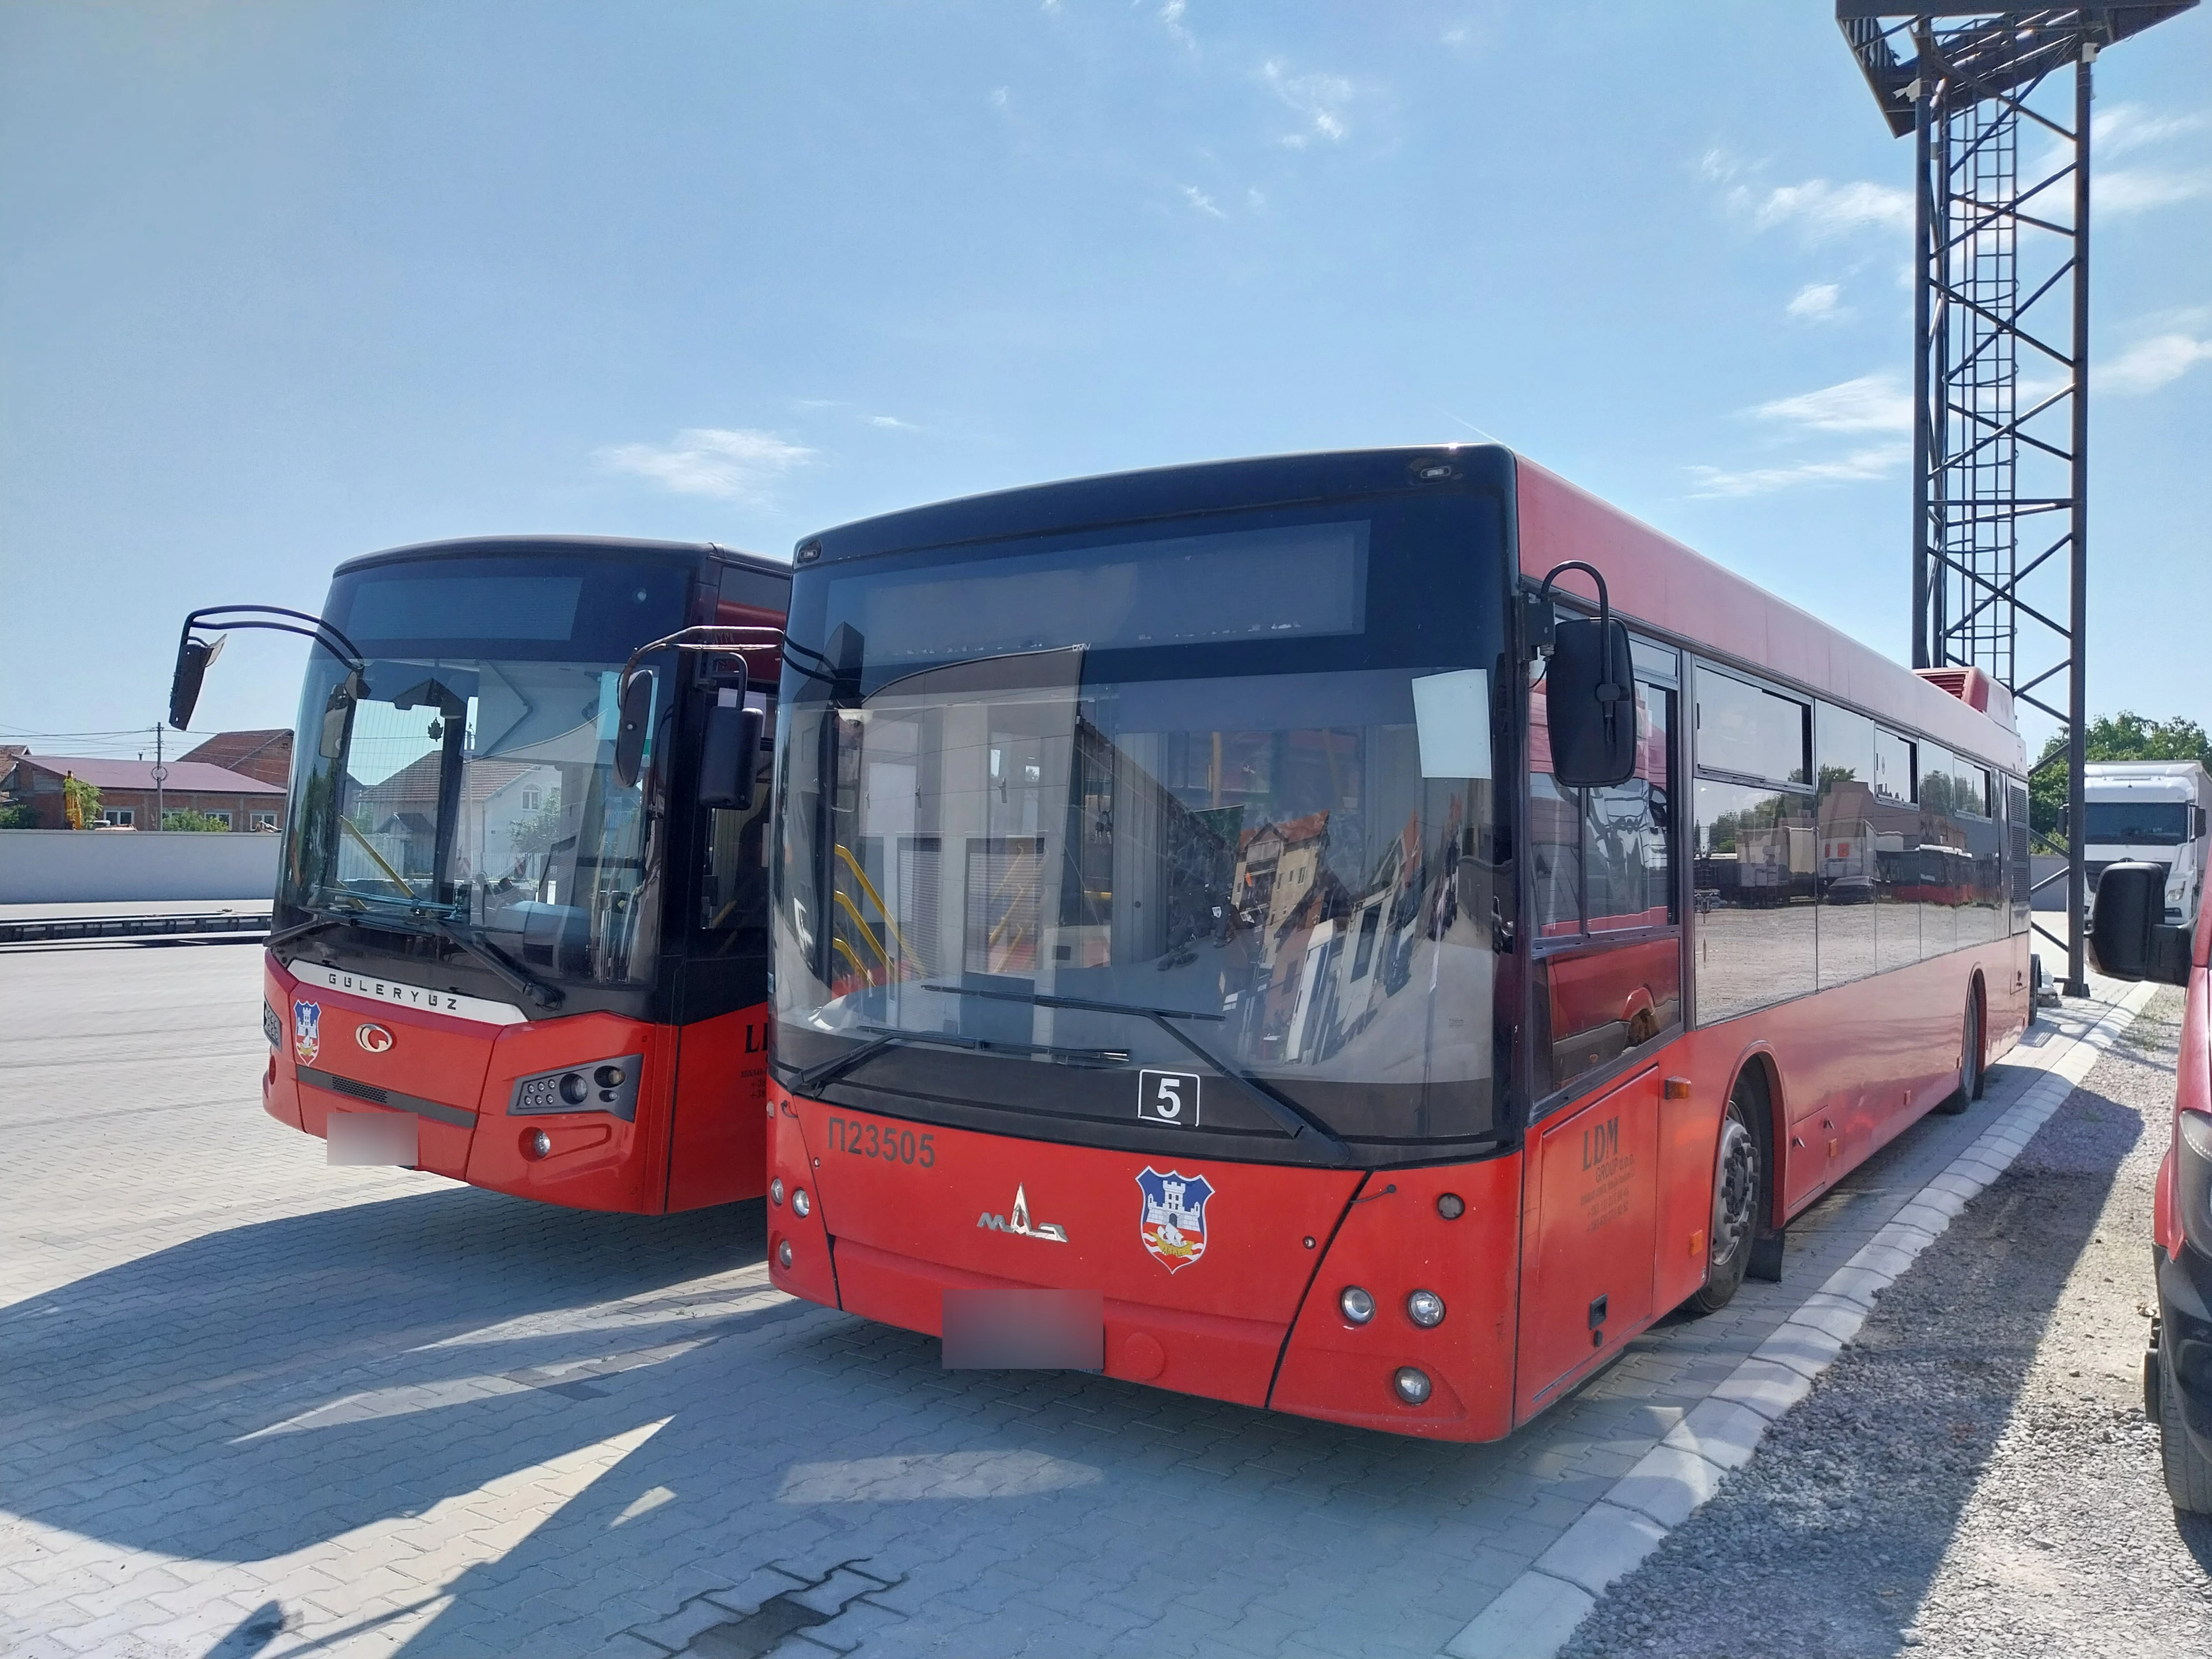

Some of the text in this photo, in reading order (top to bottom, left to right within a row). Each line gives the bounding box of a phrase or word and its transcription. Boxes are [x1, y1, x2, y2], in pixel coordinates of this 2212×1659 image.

[1157, 1078, 1181, 1118] 5
[828, 1116, 935, 1169] П23505
[1582, 1115, 1619, 1172] LDM
